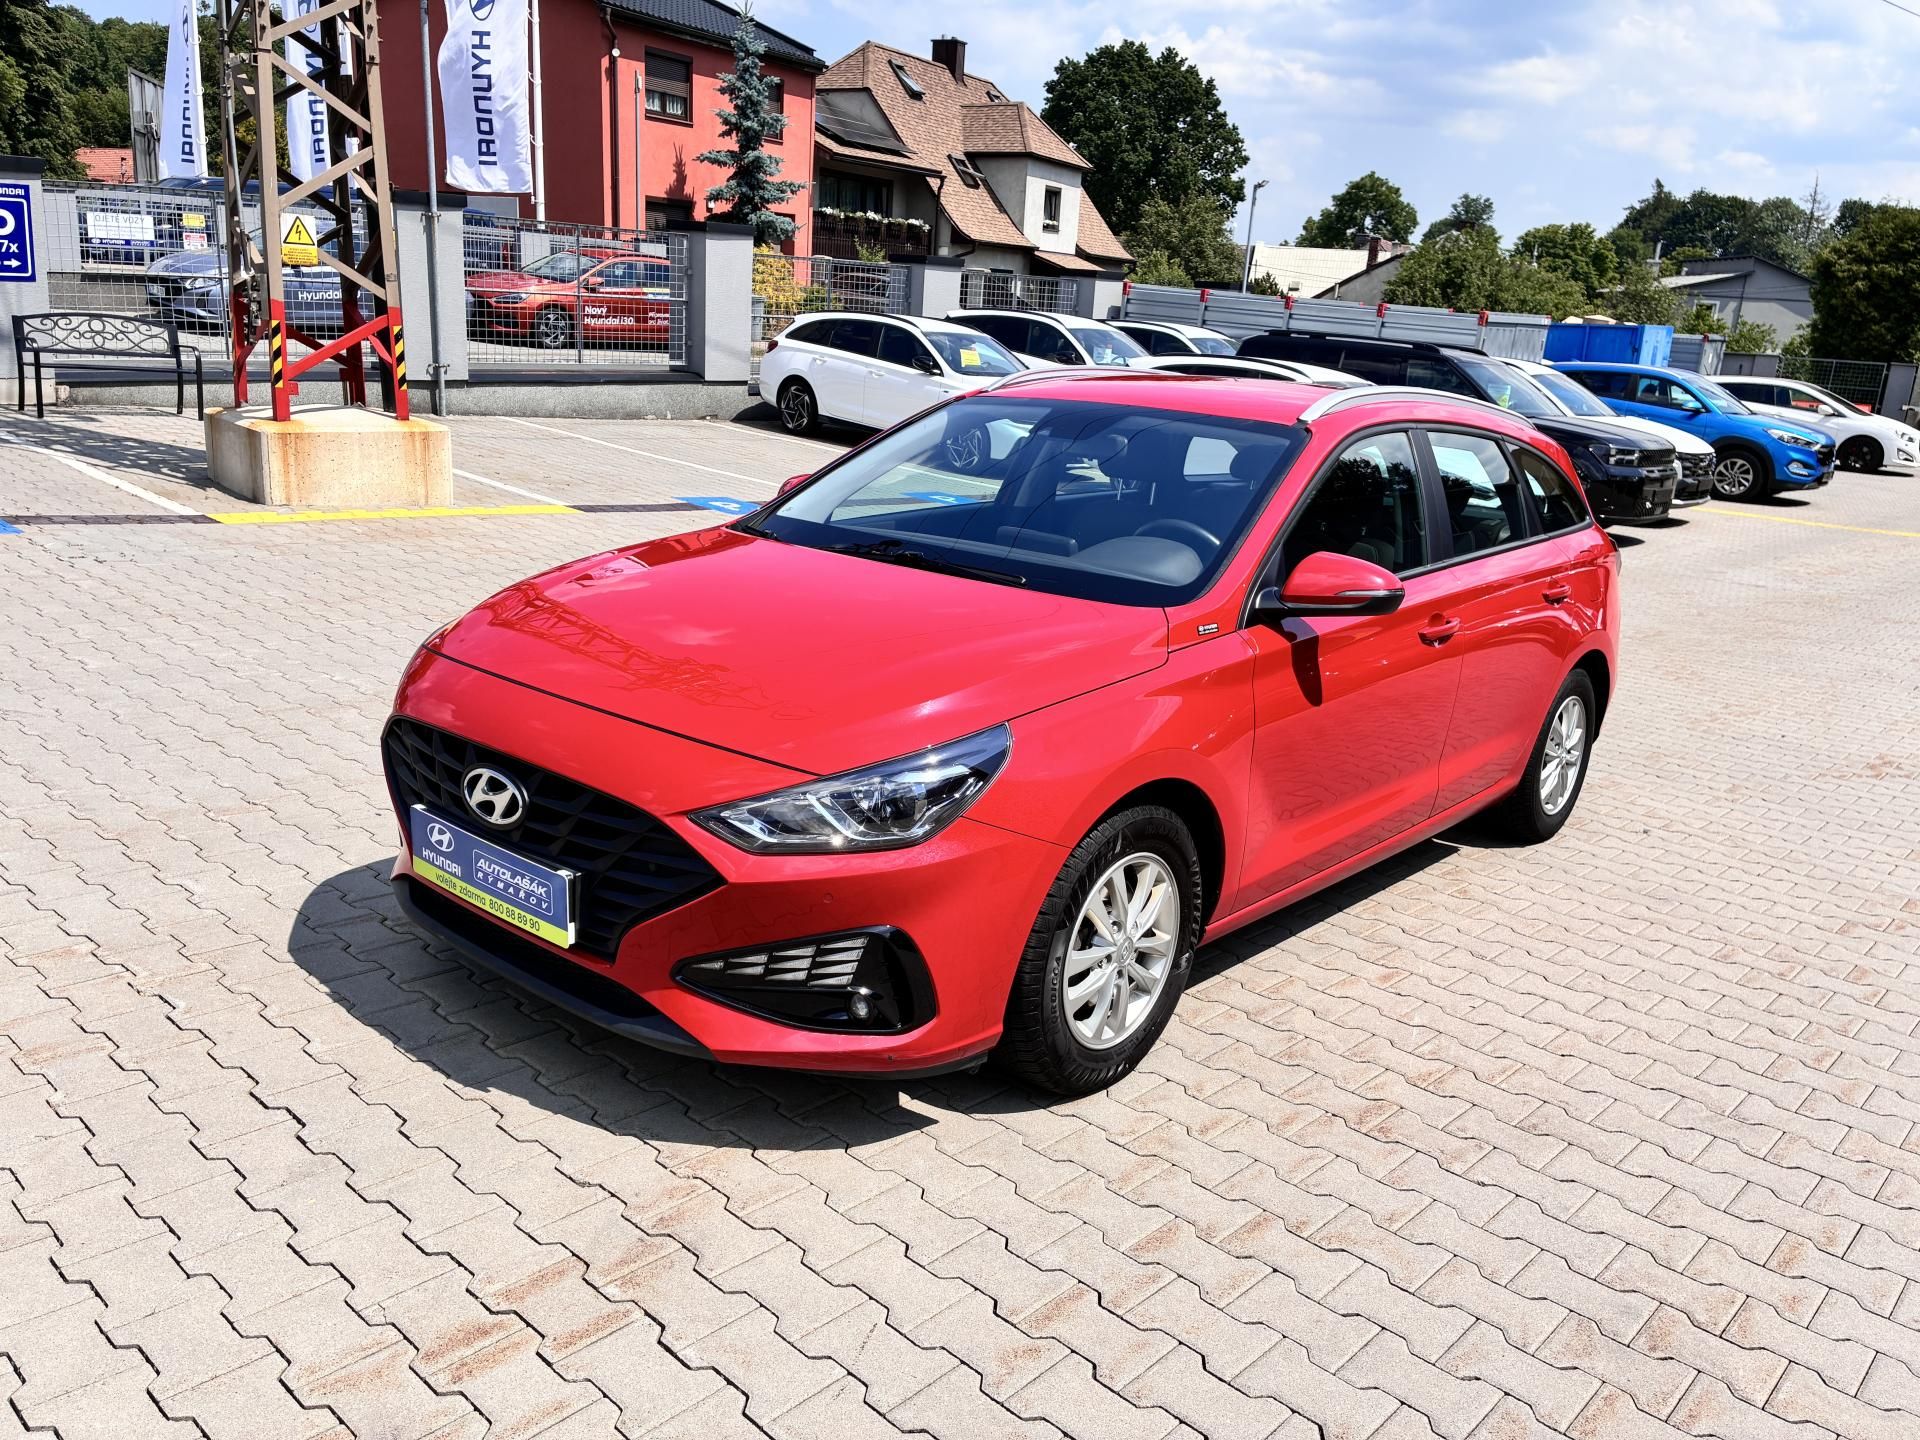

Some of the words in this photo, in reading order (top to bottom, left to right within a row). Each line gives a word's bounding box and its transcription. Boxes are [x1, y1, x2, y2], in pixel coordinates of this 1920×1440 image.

[0, 187, 25, 196] NDAI
[584, 305, 607, 316] Nový
[584, 316, 619, 327] Hyundai
[422, 847, 462, 878] HYUNDAI
[476, 858, 548, 898] AUTOLAŠÁK
[435, 871, 457, 892] volejte
[459, 884, 487, 907] zdarma
[488, 898, 504, 915] 800
[505, 906, 516, 921] 88
[517, 911, 528, 926] 89
[529, 918, 540, 932] 90
[477, 871, 549, 910] RÝMAŘOV
